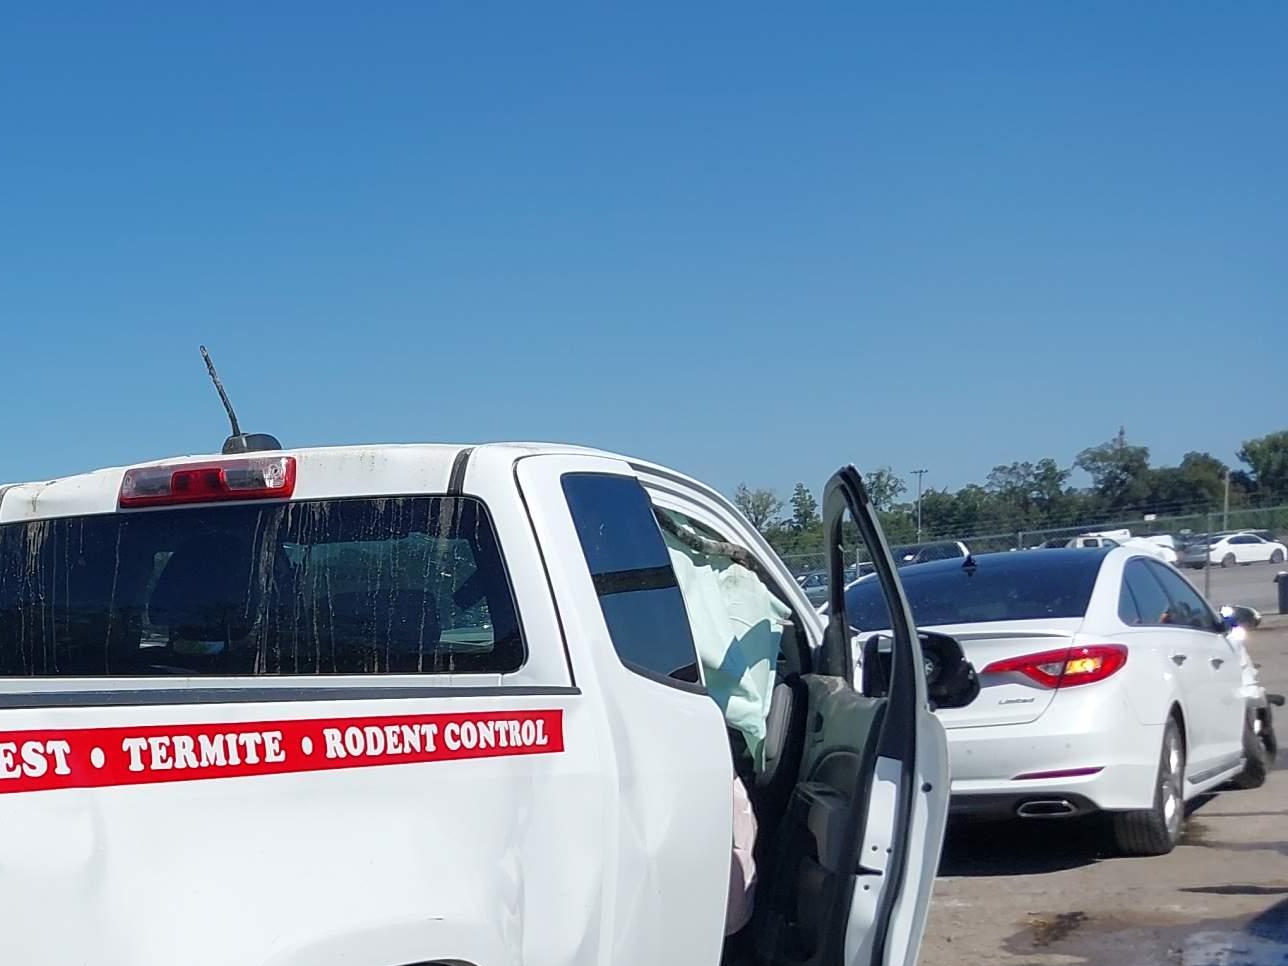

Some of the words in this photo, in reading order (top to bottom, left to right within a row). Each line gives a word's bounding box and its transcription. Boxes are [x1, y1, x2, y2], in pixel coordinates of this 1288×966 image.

[122, 731, 286, 772] TERMITE
[323, 723, 438, 759] RODENT
[444, 719, 549, 750] CONTROL
